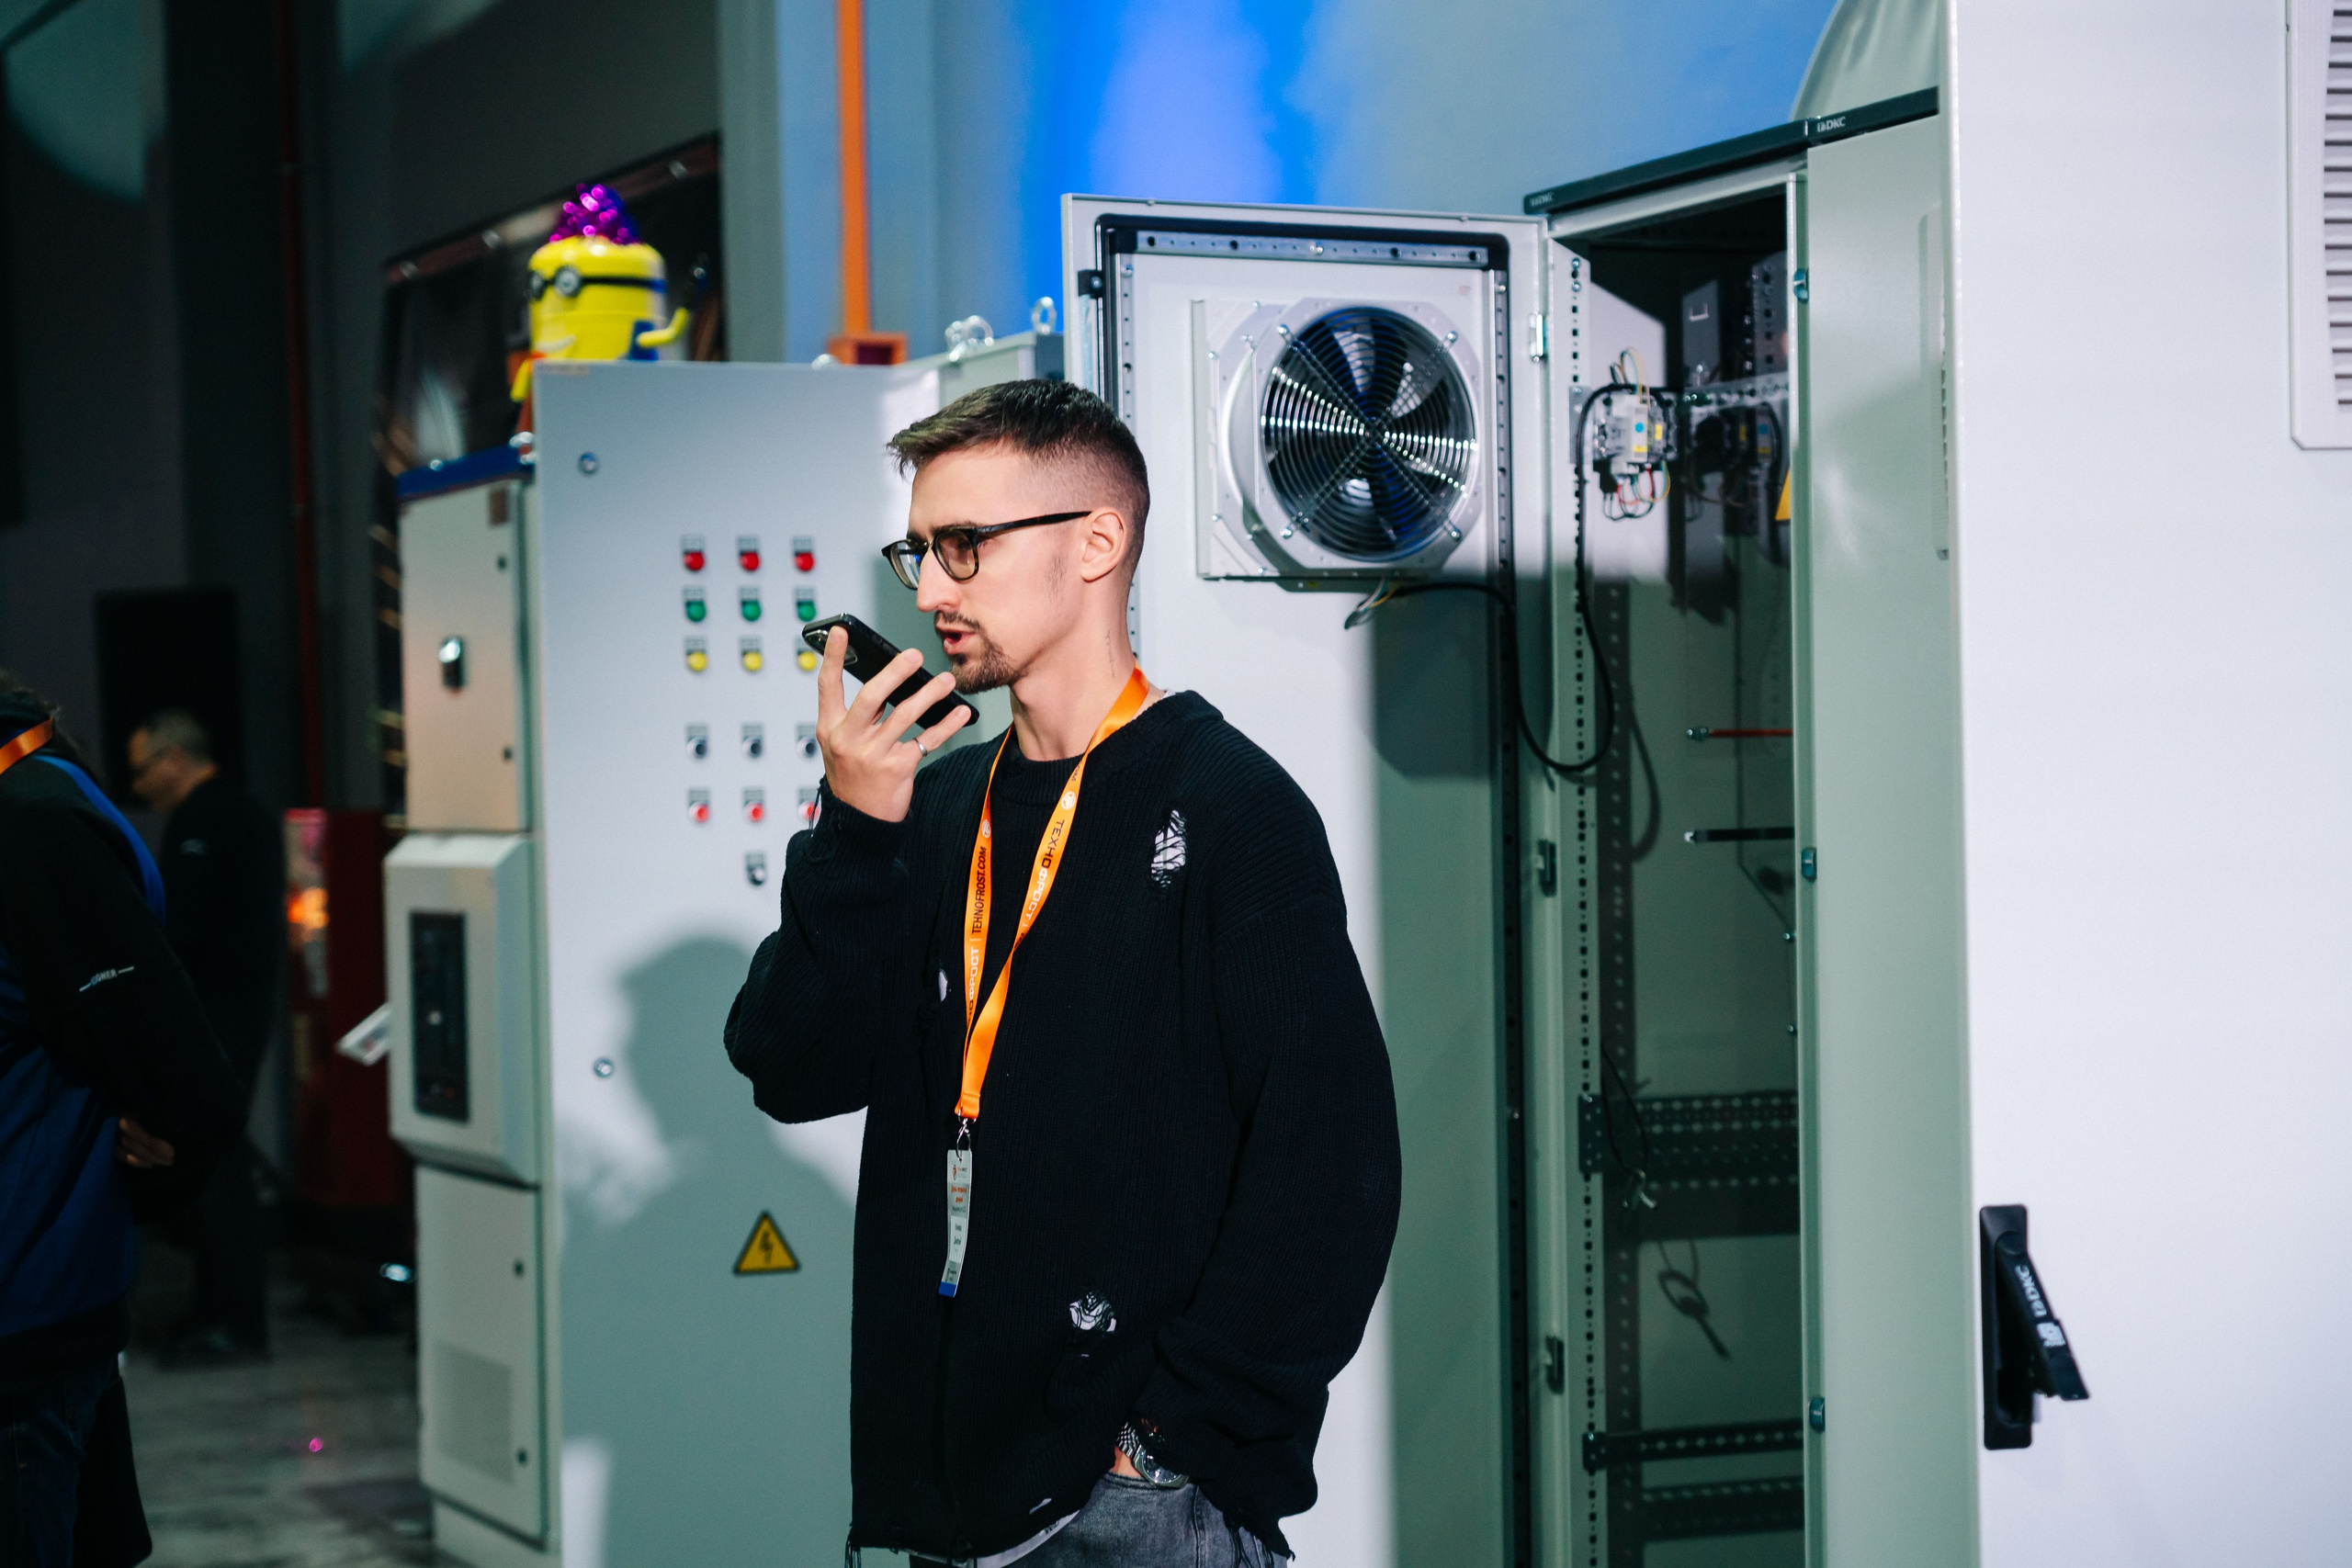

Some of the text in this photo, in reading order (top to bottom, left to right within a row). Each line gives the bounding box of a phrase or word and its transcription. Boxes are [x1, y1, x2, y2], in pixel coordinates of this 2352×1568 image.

[1826, 116, 1846, 130] DKC
[971, 846, 987, 934] TEHNOFROST.COM
[1024, 819, 1065, 920] ТЕХНОФРОСТ
[2015, 1265, 2041, 1302] DKC
